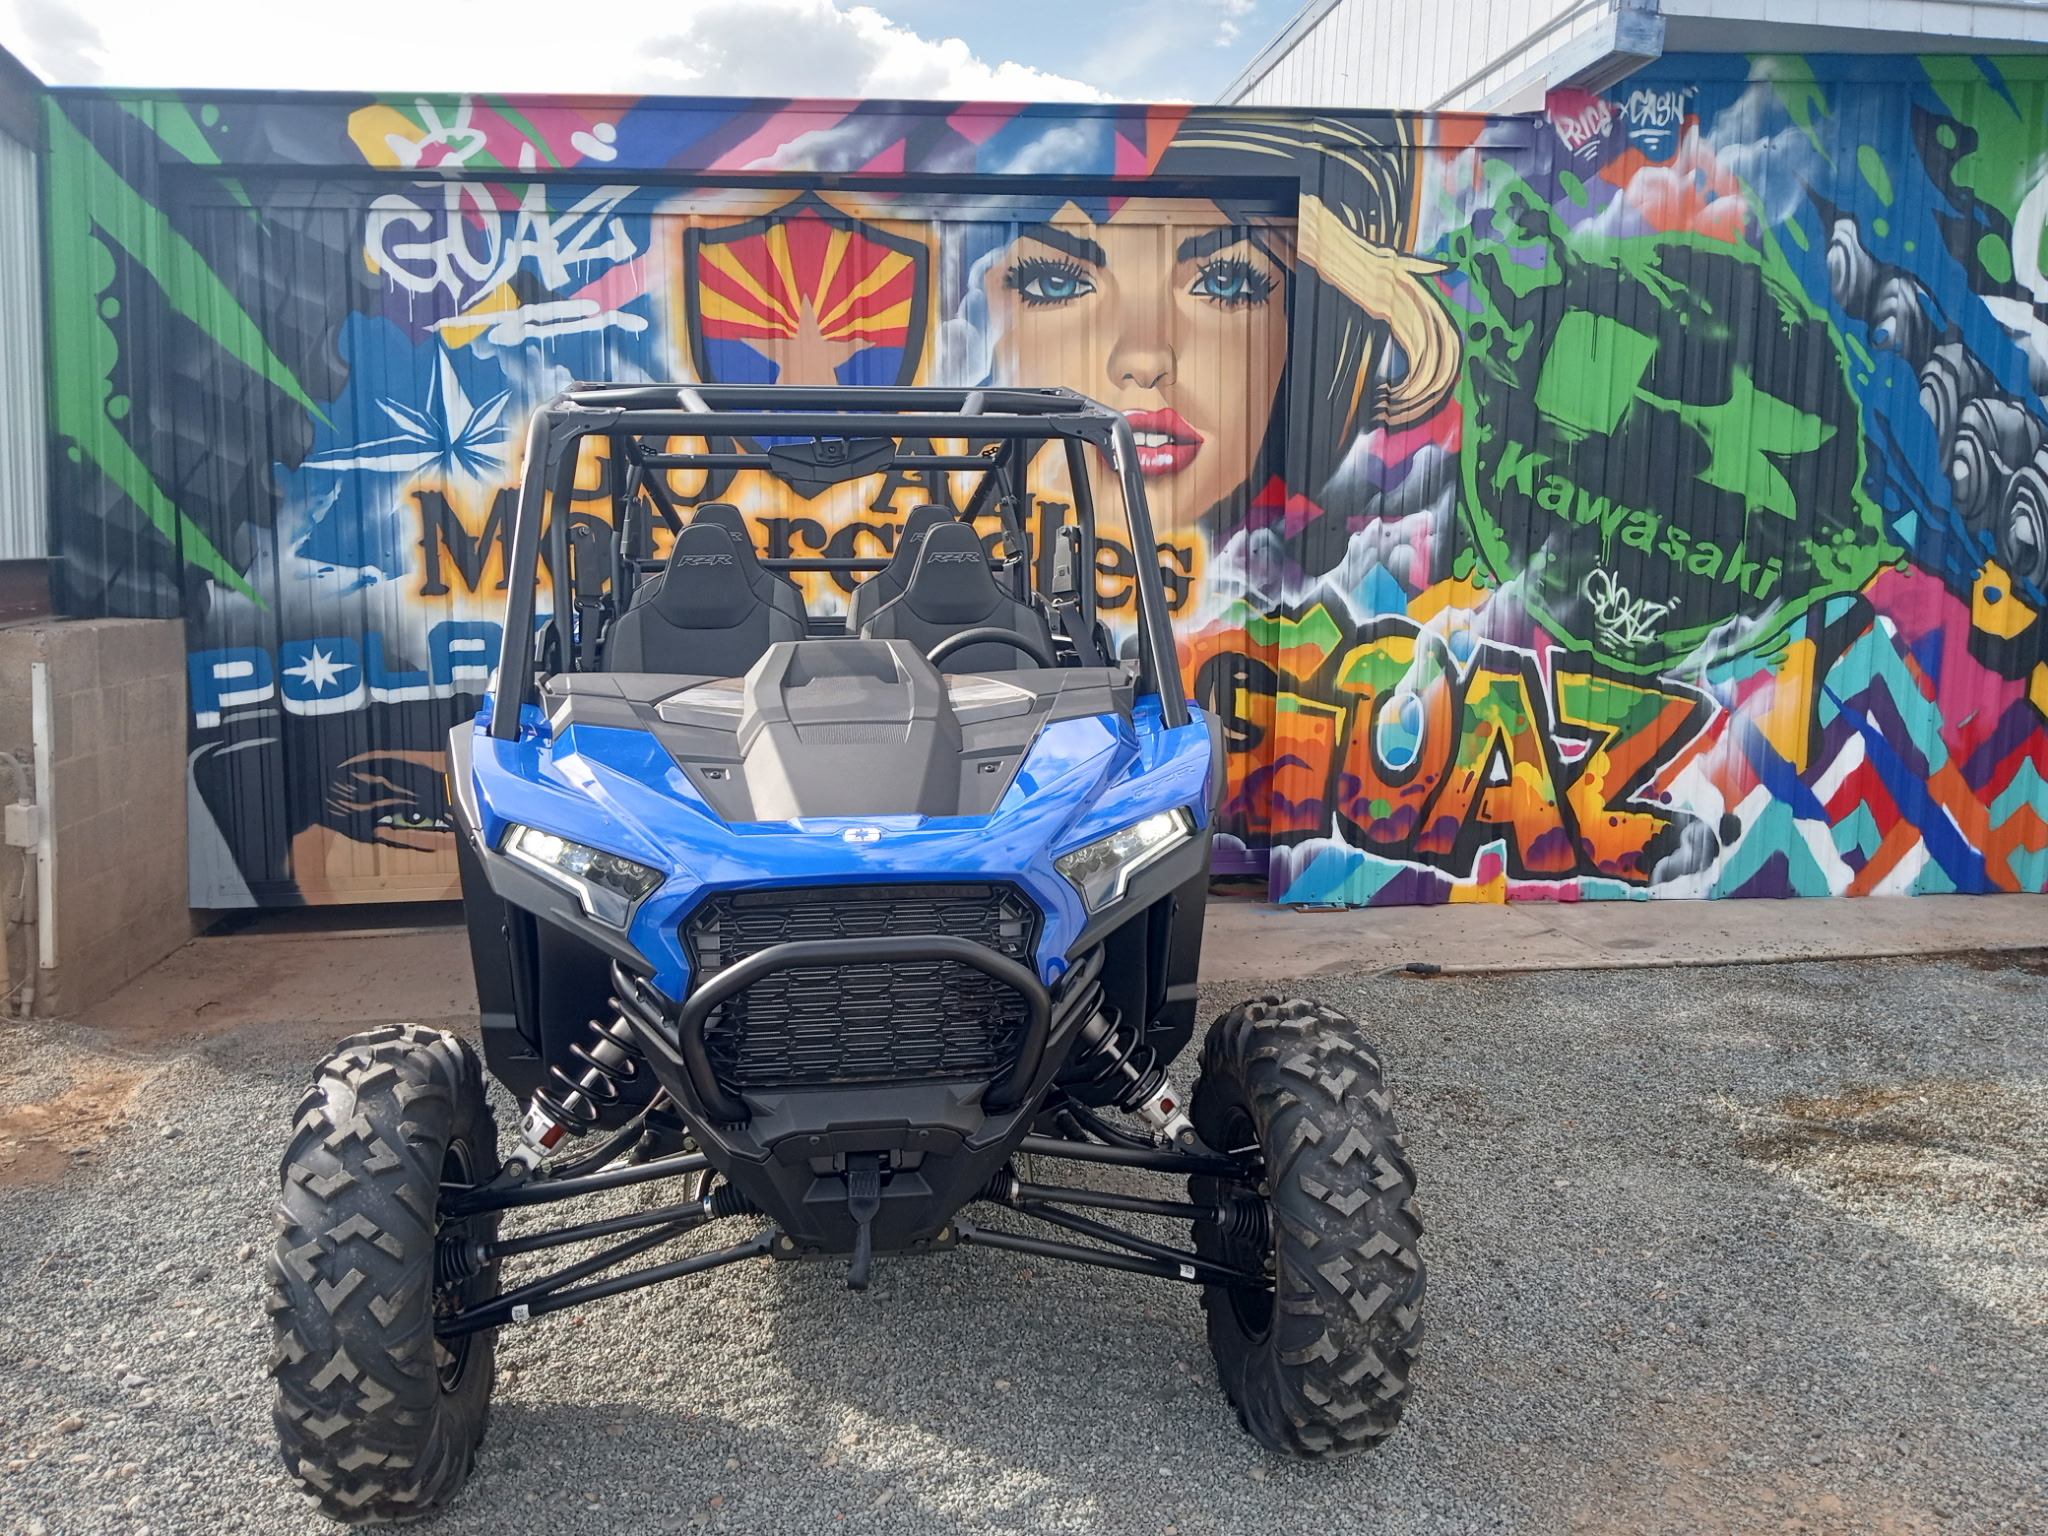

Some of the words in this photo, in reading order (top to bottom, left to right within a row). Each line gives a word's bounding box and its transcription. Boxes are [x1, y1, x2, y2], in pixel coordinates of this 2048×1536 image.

[1629, 88, 1685, 127] CASH
[1490, 440, 1783, 600] Kawasaki
[677, 554, 733, 567] RZR
[926, 551, 980, 565] RZR
[187, 620, 553, 729] POLA
[1194, 598, 1718, 884] GOAZ
